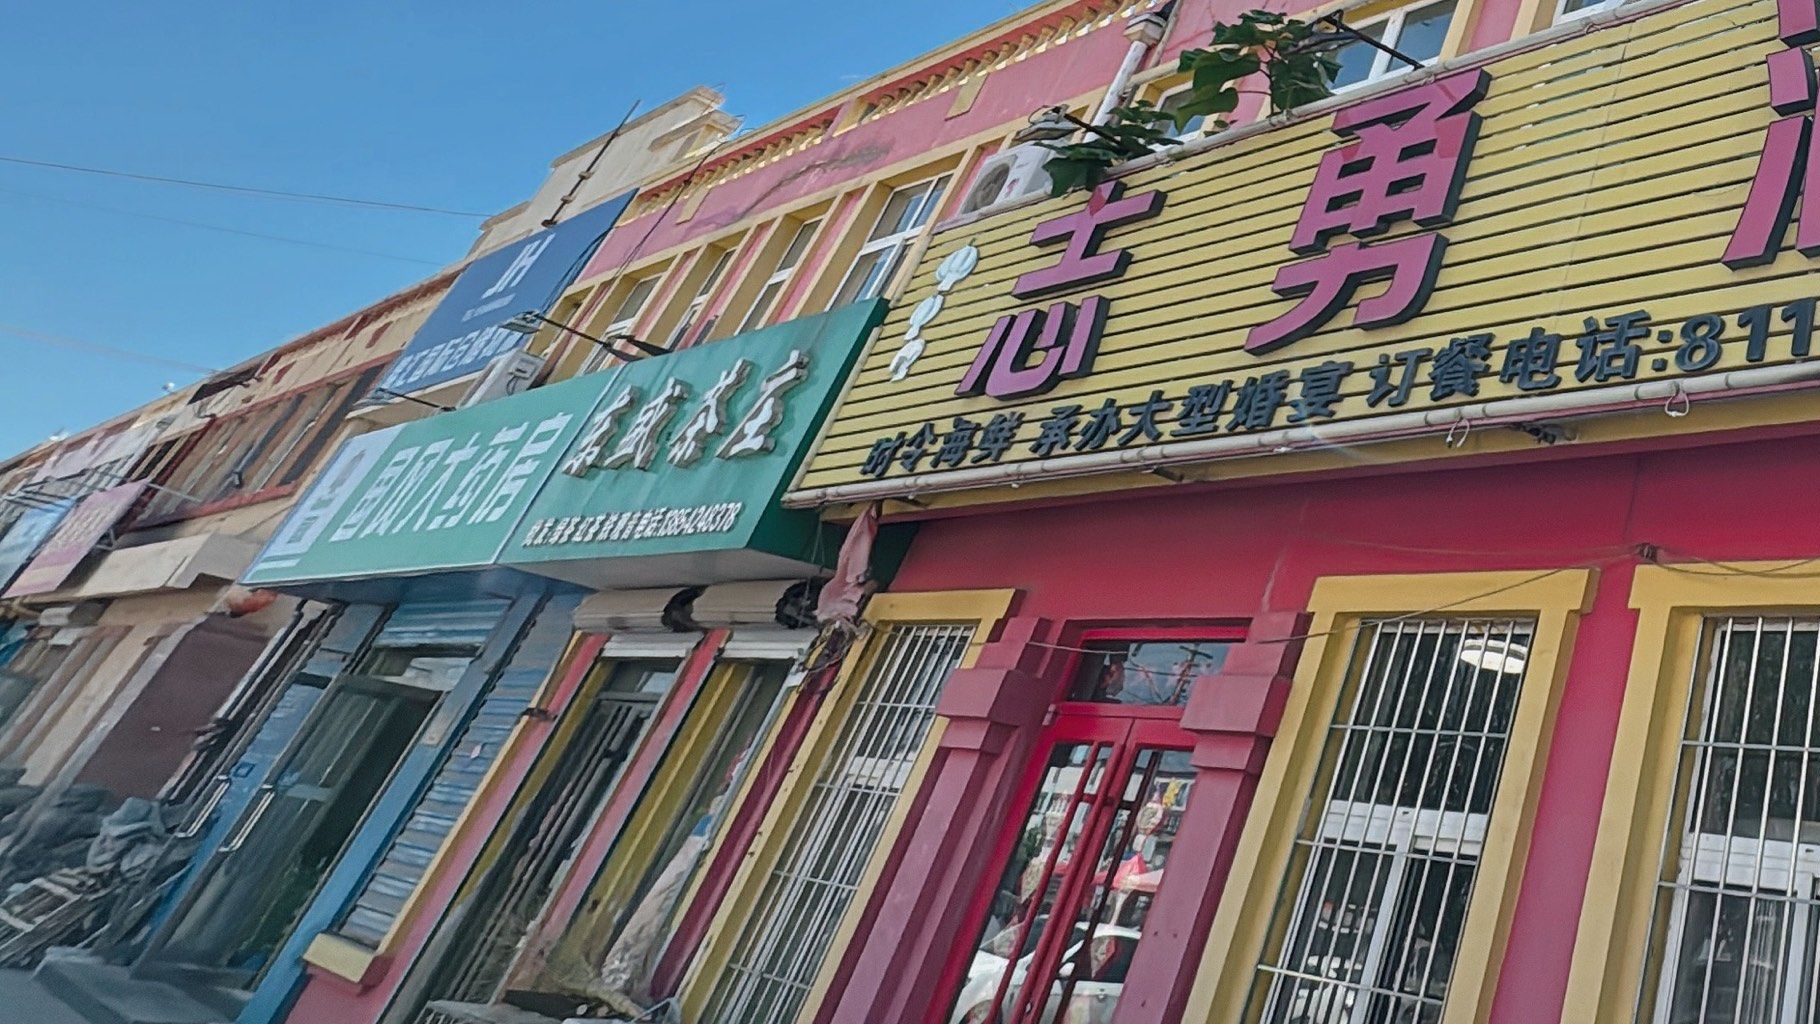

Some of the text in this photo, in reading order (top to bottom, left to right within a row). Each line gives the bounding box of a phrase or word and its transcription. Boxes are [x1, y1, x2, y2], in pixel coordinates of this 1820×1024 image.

[1030, 359, 1353, 457] 承办大型婚宴
